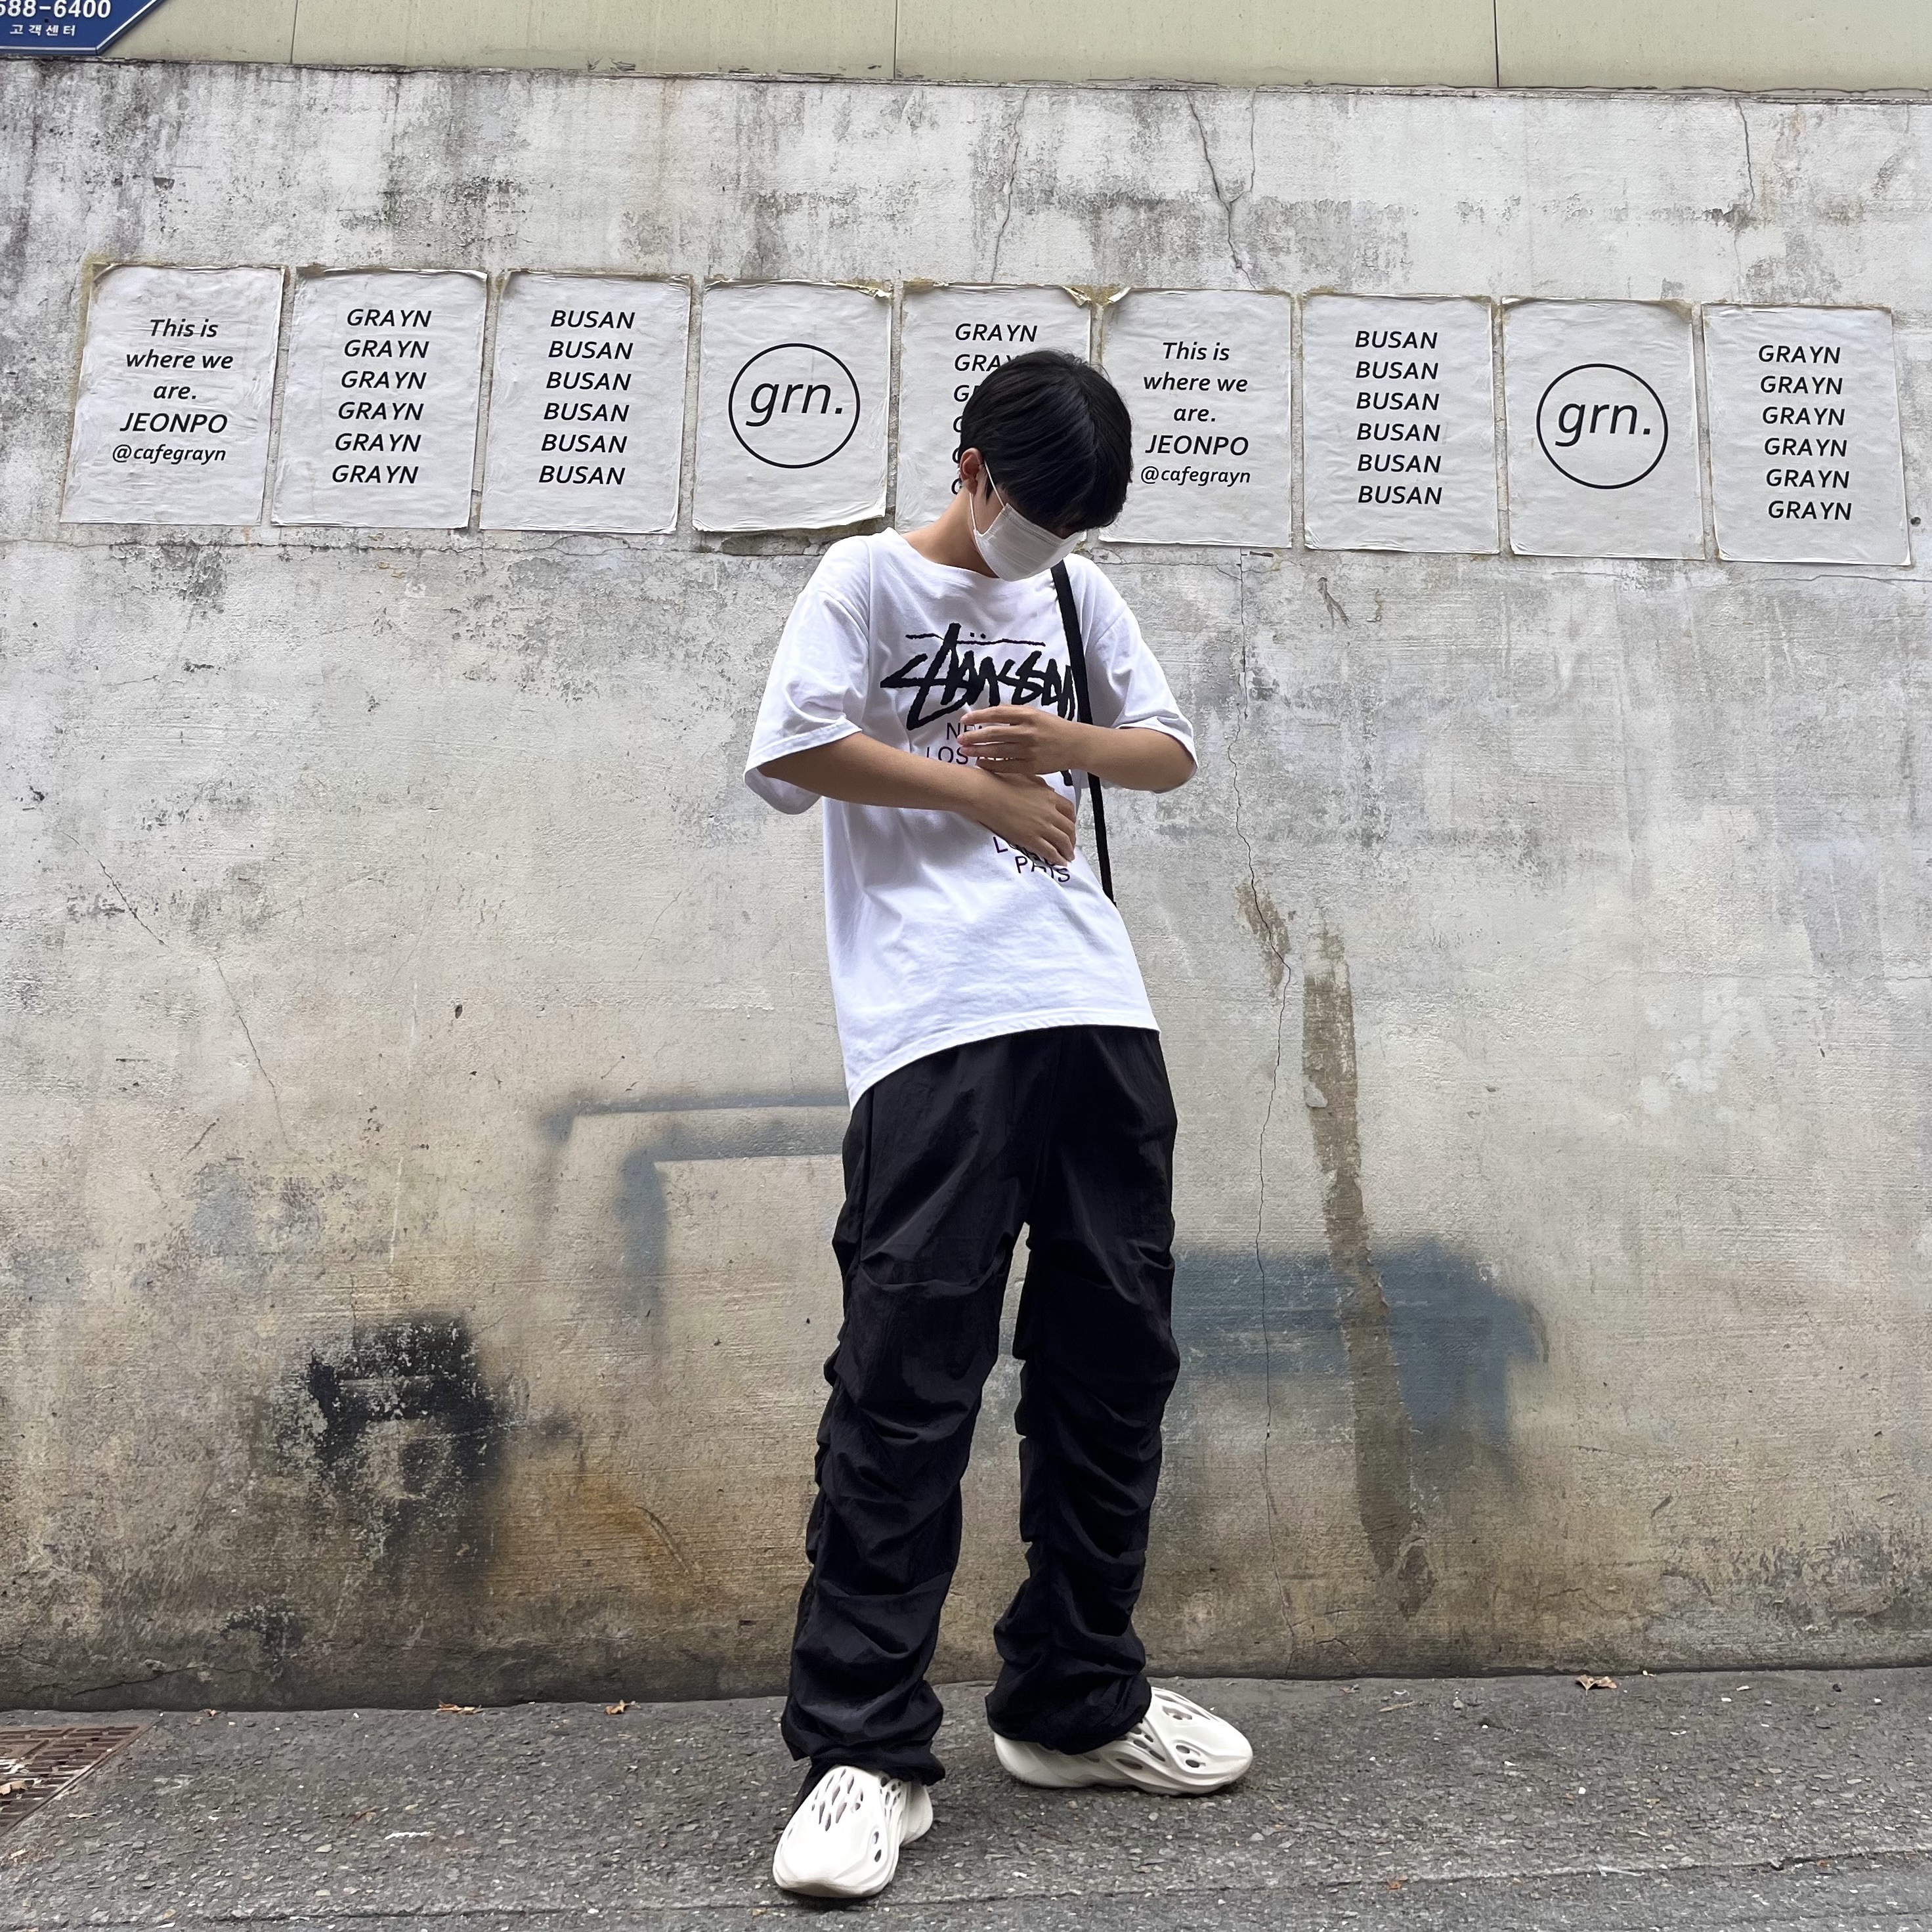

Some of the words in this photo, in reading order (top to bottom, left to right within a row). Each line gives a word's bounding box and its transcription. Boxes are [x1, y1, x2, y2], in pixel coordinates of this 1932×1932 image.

[10, 24, 76, 37] 고객센터
[150, 318, 194, 337] This
[200, 319, 219, 337] is
[347, 309, 432, 328] GRAYN
[550, 310, 635, 329] BUSAN
[955, 323, 1038, 342] GRAYN
[1355, 330, 1438, 349] BUSAN
[344, 339, 429, 358] GRAYN
[548, 341, 633, 360] BUSAN
[1162, 341, 1207, 361] This
[1212, 342, 1230, 361] is
[1759, 345, 1841, 364] GRAYN
[126, 349, 196, 369] where
[202, 354, 234, 369] we
[954, 354, 1019, 372] GRA
[341, 370, 427, 389] GRAYN
[1356, 361, 1438, 379] BUSAN
[546, 372, 632, 391] BUSAN
[1144, 371, 1211, 392] where
[1216, 377, 1248, 393] we
[1761, 376, 1843, 395] GRAYN
[153, 385, 197, 400] are.
[1356, 392, 1440, 411] BUSAN
[338, 401, 424, 421] GRAYN
[544, 402, 630, 422] BUSAN
[745, 383, 843, 427] grn.
[1173, 407, 1216, 422] are.
[119, 412, 228, 433] JEONPO
[1555, 402, 1651, 447] grn.
[1763, 406, 1845, 426] GRAYN
[1356, 423, 1440, 442] BUSAN
[335, 433, 421, 452] GRAYN
[541, 433, 628, 454] BUSAN
[1145, 435, 1249, 456] JEONPO
[1764, 437, 1847, 457] GRAYN
[112, 443, 226, 465] @cafegrayn
[1357, 454, 1442, 473] BUSAN
[332, 464, 419, 484] GRAYN
[538, 465, 626, 485] BUSAN
[1140, 465, 1251, 487] @cafegrayn
[1766, 469, 1849, 489] GRAYN
[1358, 485, 1442, 505] BUSAN
[1768, 500, 1852, 521] GRAYN
